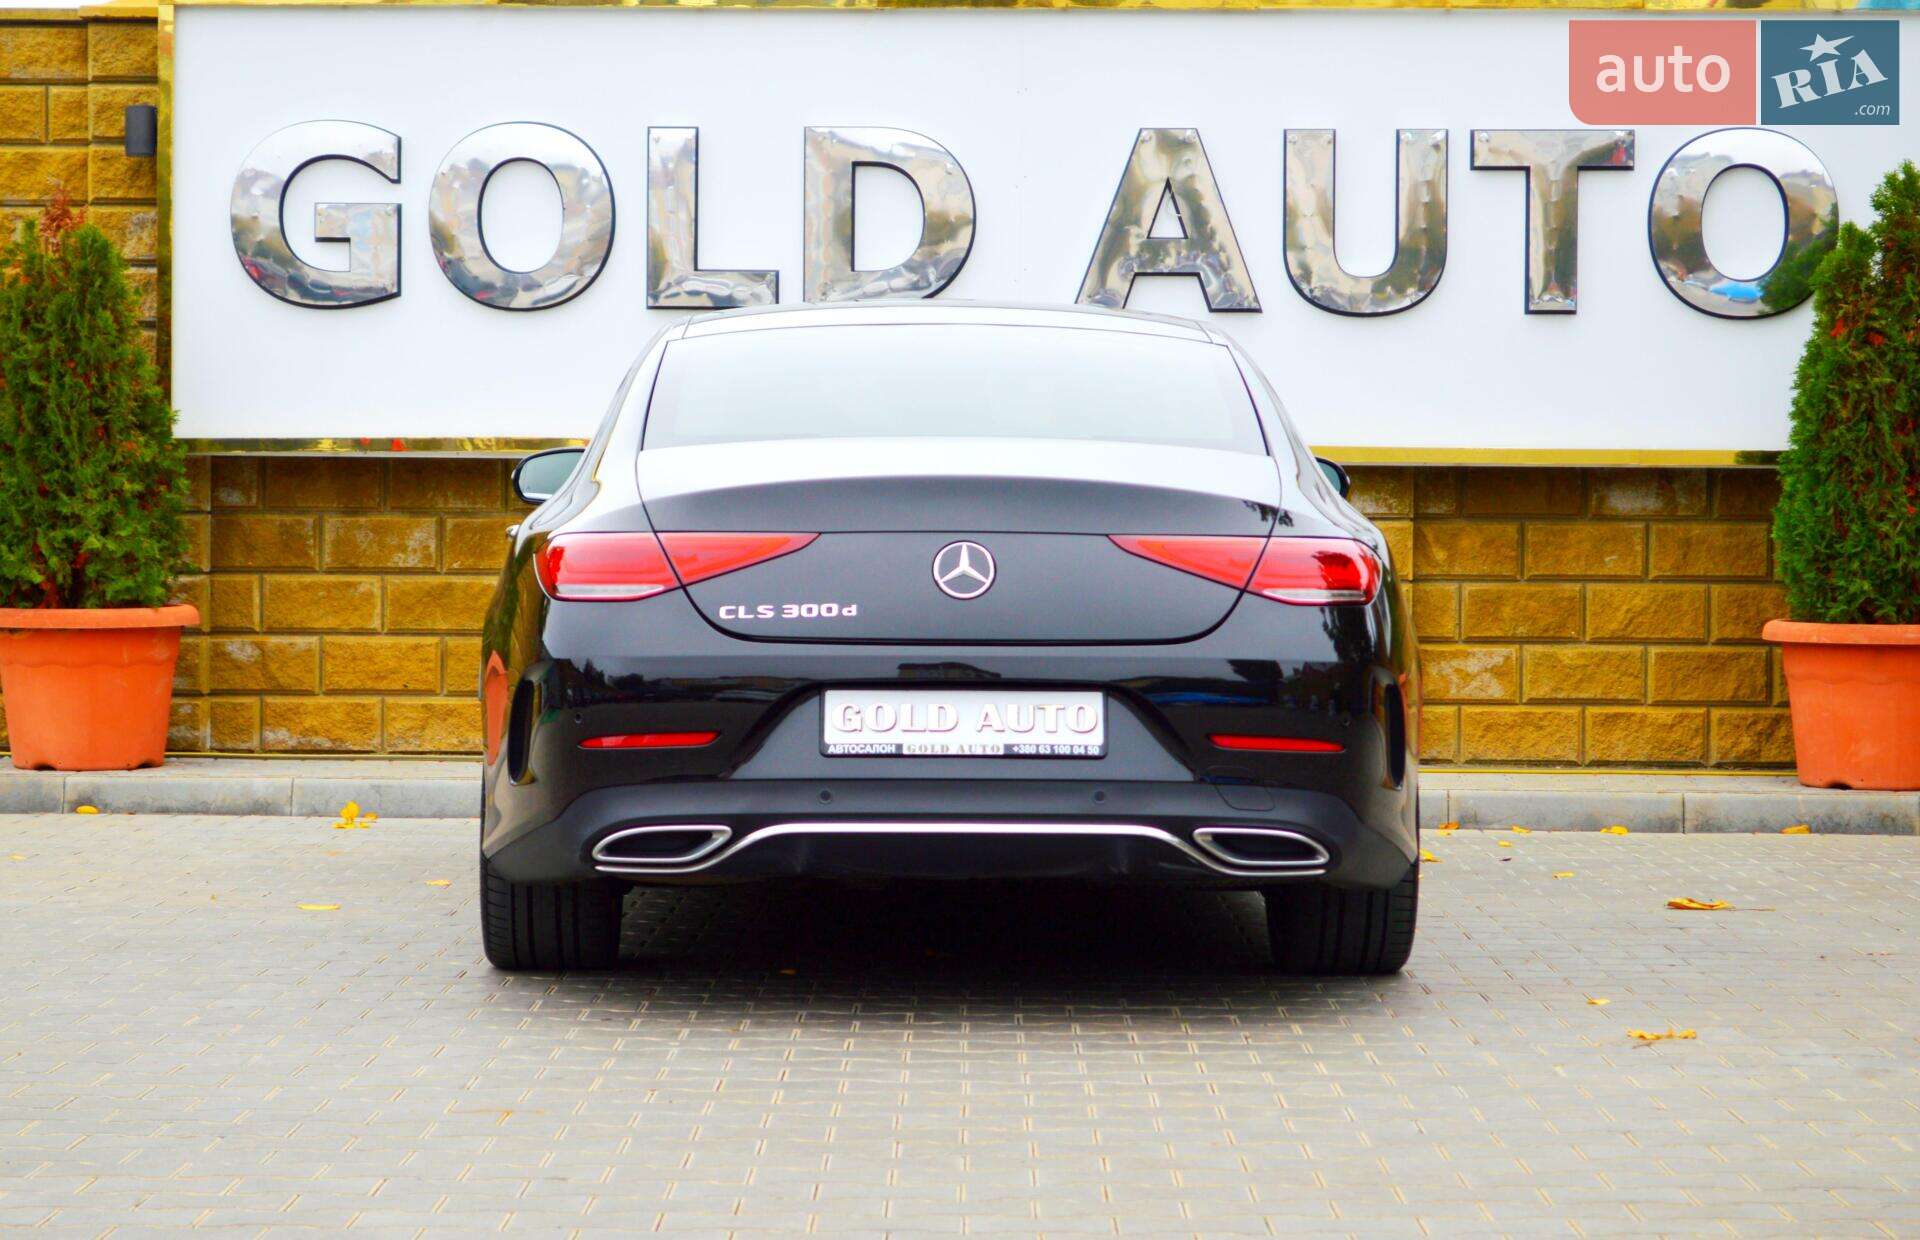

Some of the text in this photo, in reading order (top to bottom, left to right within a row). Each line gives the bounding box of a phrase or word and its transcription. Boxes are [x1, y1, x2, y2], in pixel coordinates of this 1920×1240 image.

[230, 119, 1840, 320] GOLD AUTO
[718, 605, 775, 619] CLS
[831, 703, 1099, 734] GOLD AUTO
[827, 744, 897, 754] АВТОСАЛОН
[906, 744, 1001, 754] GOLD AUTO
